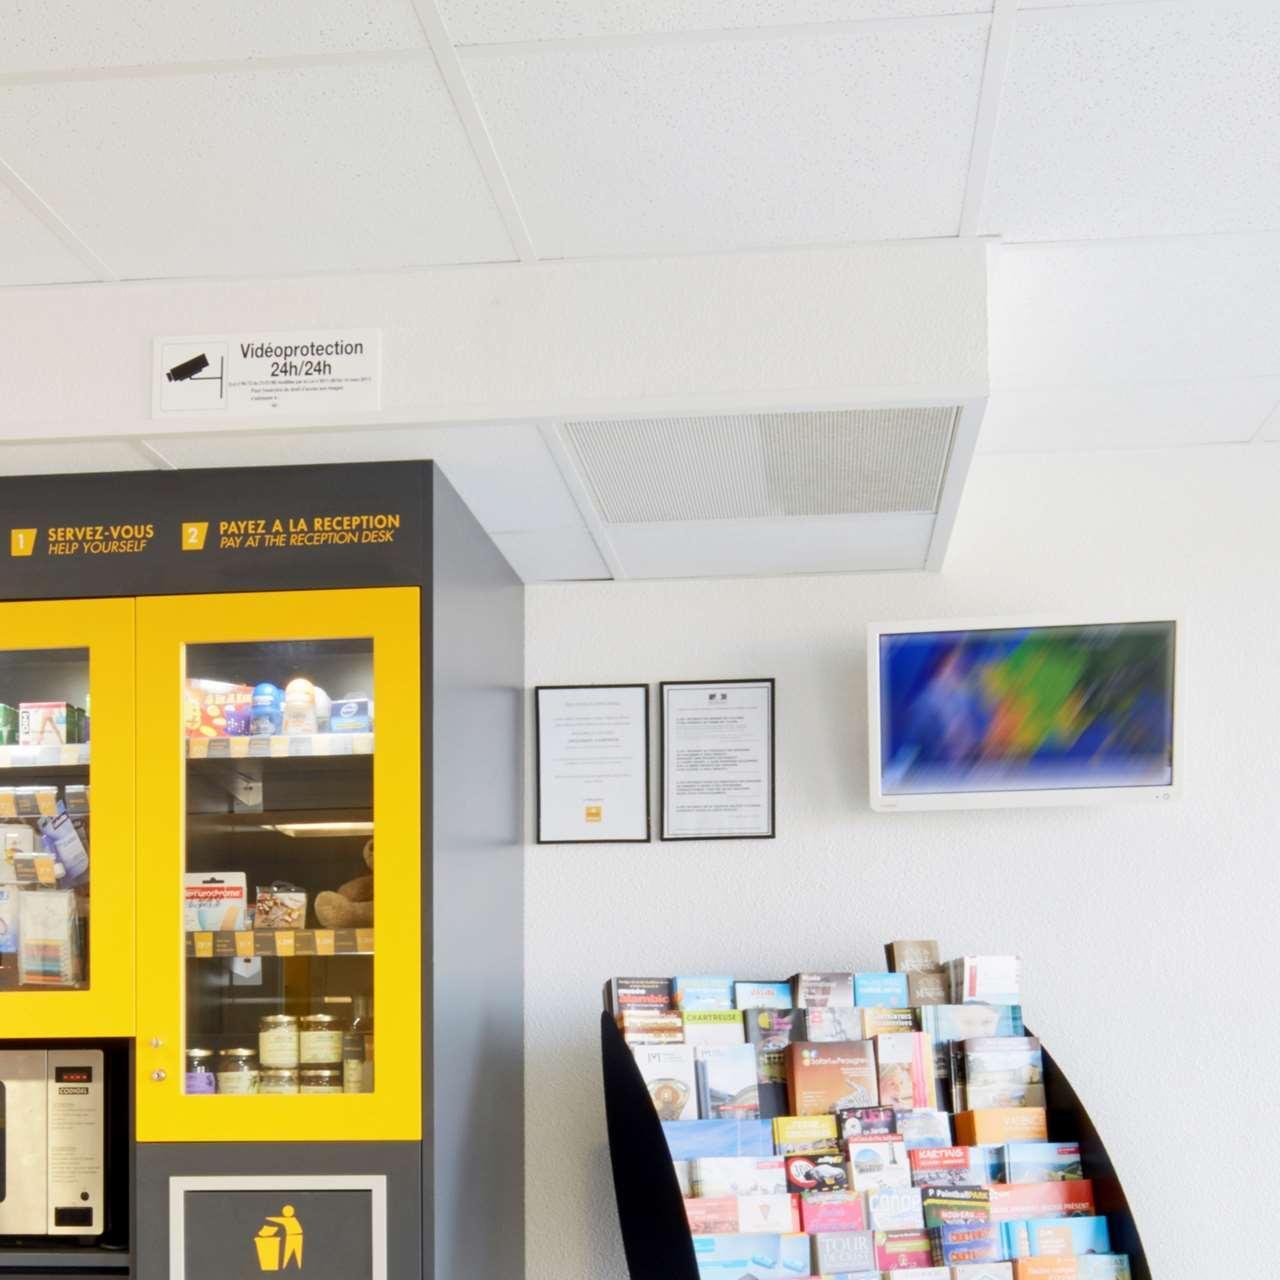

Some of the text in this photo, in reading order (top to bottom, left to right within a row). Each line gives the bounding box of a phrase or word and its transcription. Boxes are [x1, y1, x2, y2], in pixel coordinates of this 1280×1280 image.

[240, 340, 364, 360] Vidéoprotection
[270, 360, 332, 378] 24h/24h
[48, 524, 154, 542] SERVEZ-VOUS
[220, 514, 401, 535] PAYEZ A LA RECEPTION
[18, 534, 25, 548] 1
[187, 528, 199, 544] 2
[220, 529, 394, 549] PAY AT THE RECEPTION DESK
[48, 539, 147, 555] HELP YOURSELF
[822, 1236, 868, 1251] TOUR
